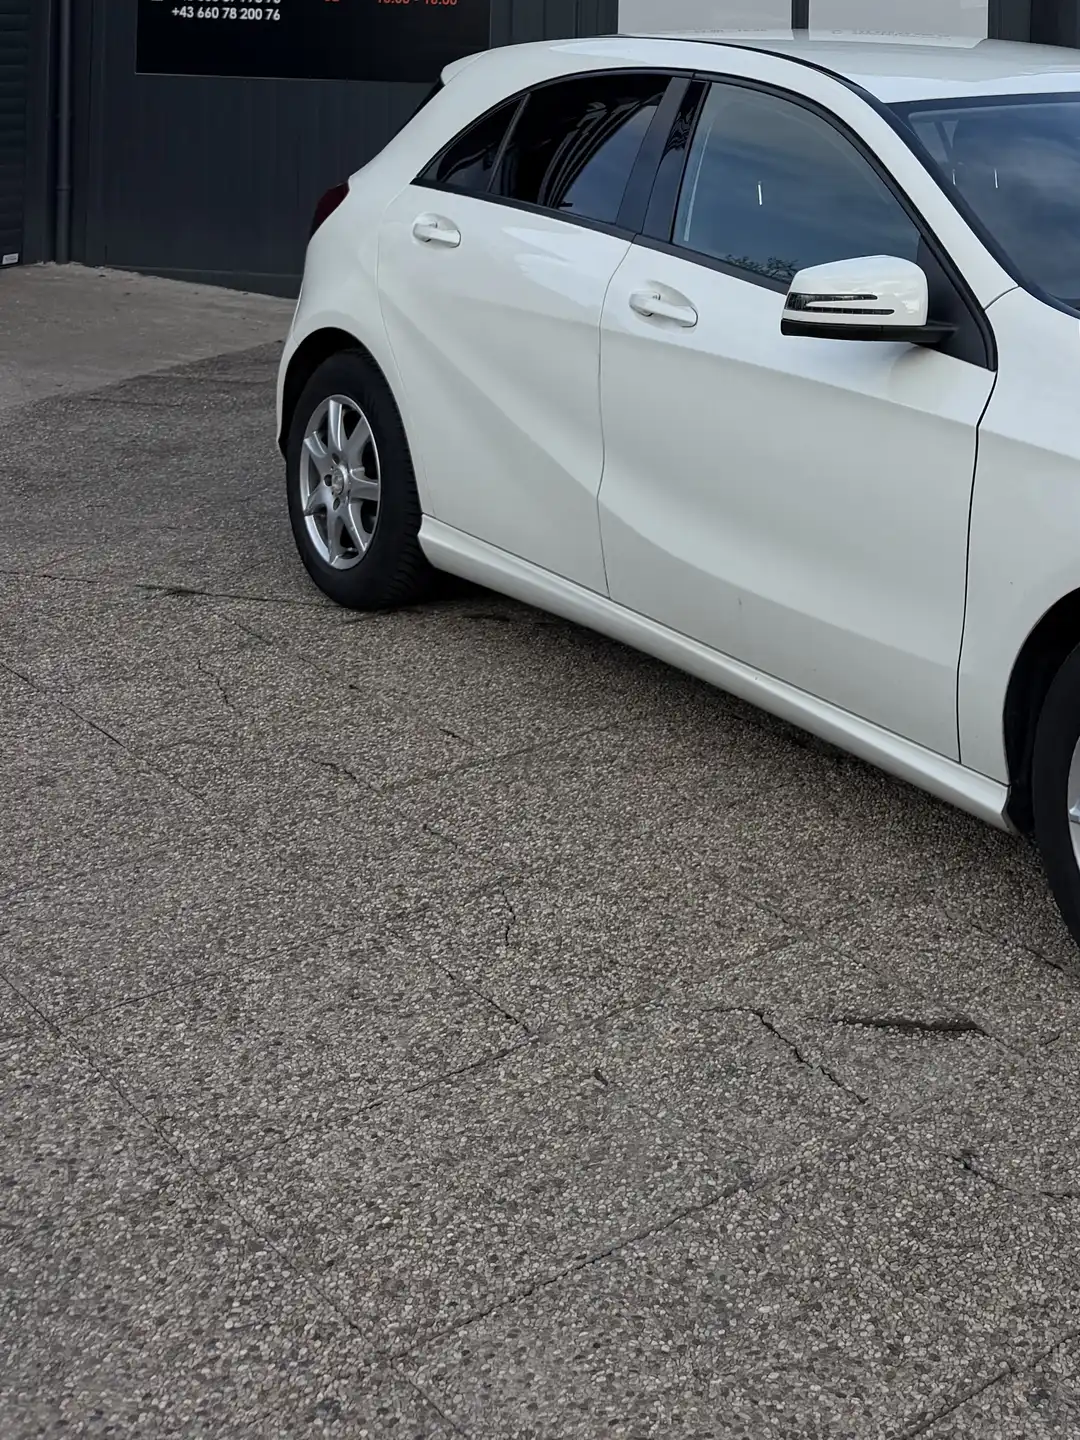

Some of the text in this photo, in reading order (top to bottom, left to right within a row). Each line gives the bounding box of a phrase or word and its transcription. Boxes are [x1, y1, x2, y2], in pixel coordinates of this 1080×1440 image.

[172, 6, 281, 21] +43 660 78 200 76
